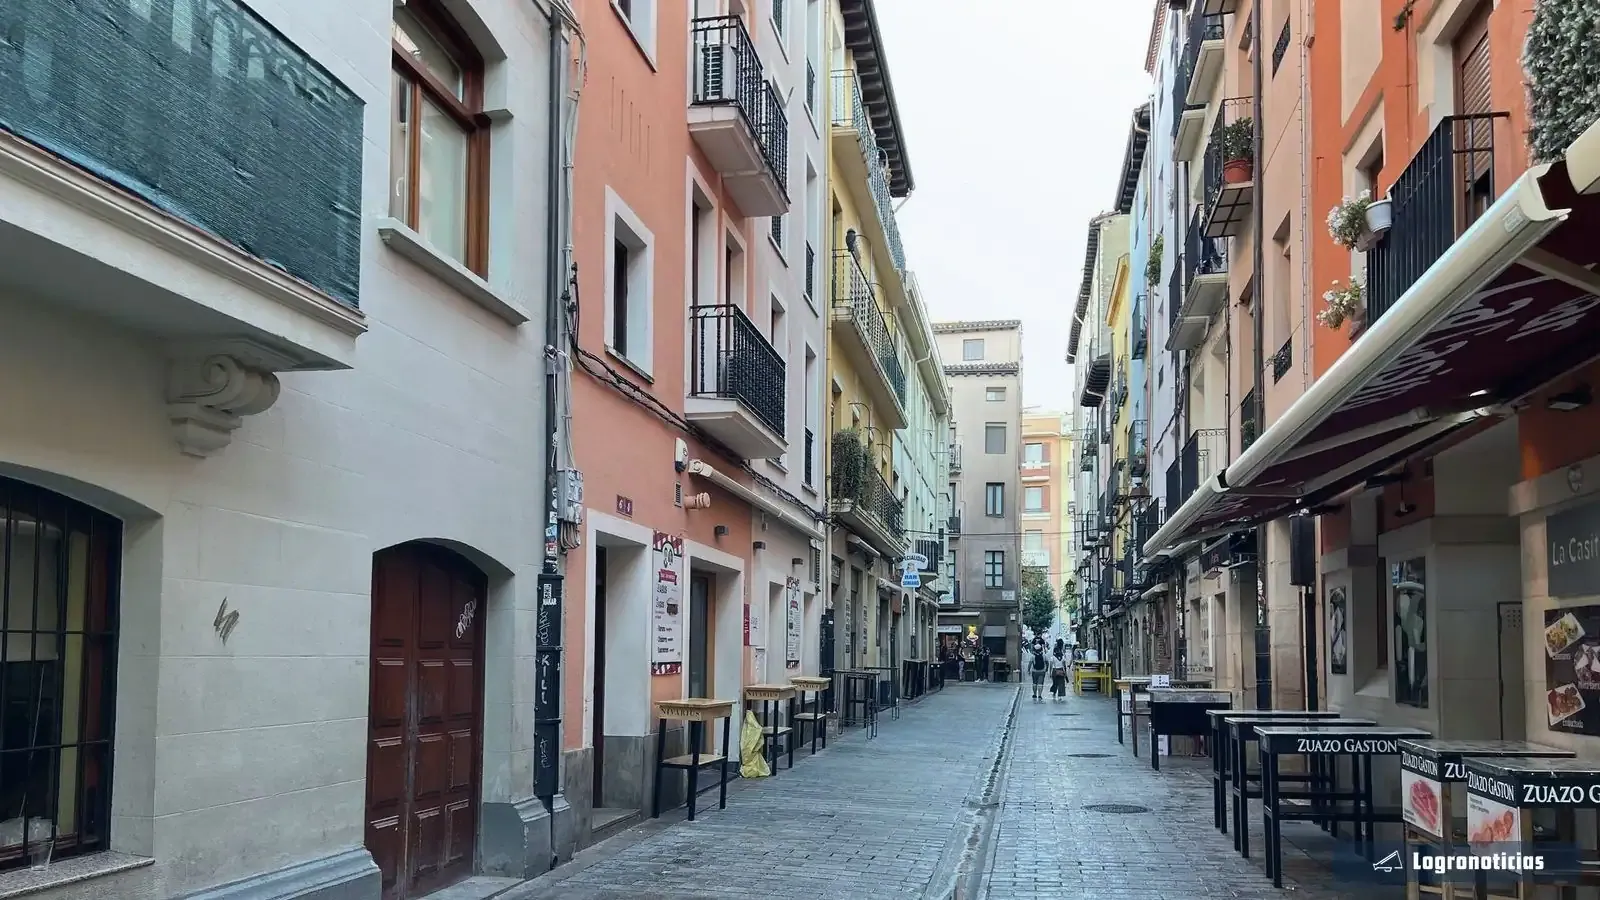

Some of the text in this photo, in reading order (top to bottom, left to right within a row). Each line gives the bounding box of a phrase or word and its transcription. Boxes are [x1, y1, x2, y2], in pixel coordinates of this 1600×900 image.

[1552, 541, 1565, 565] La
[660, 706, 700, 717] NIVARIUS
[1296, 738, 1398, 753] ZUAZO GASTON
[1401, 751, 1438, 776] ZUAZO GASTON
[1444, 762, 1468, 779] ZU
[1467, 771, 1515, 802] ZUAZO GASTON
[1522, 784, 1586, 803] ZUAZO
